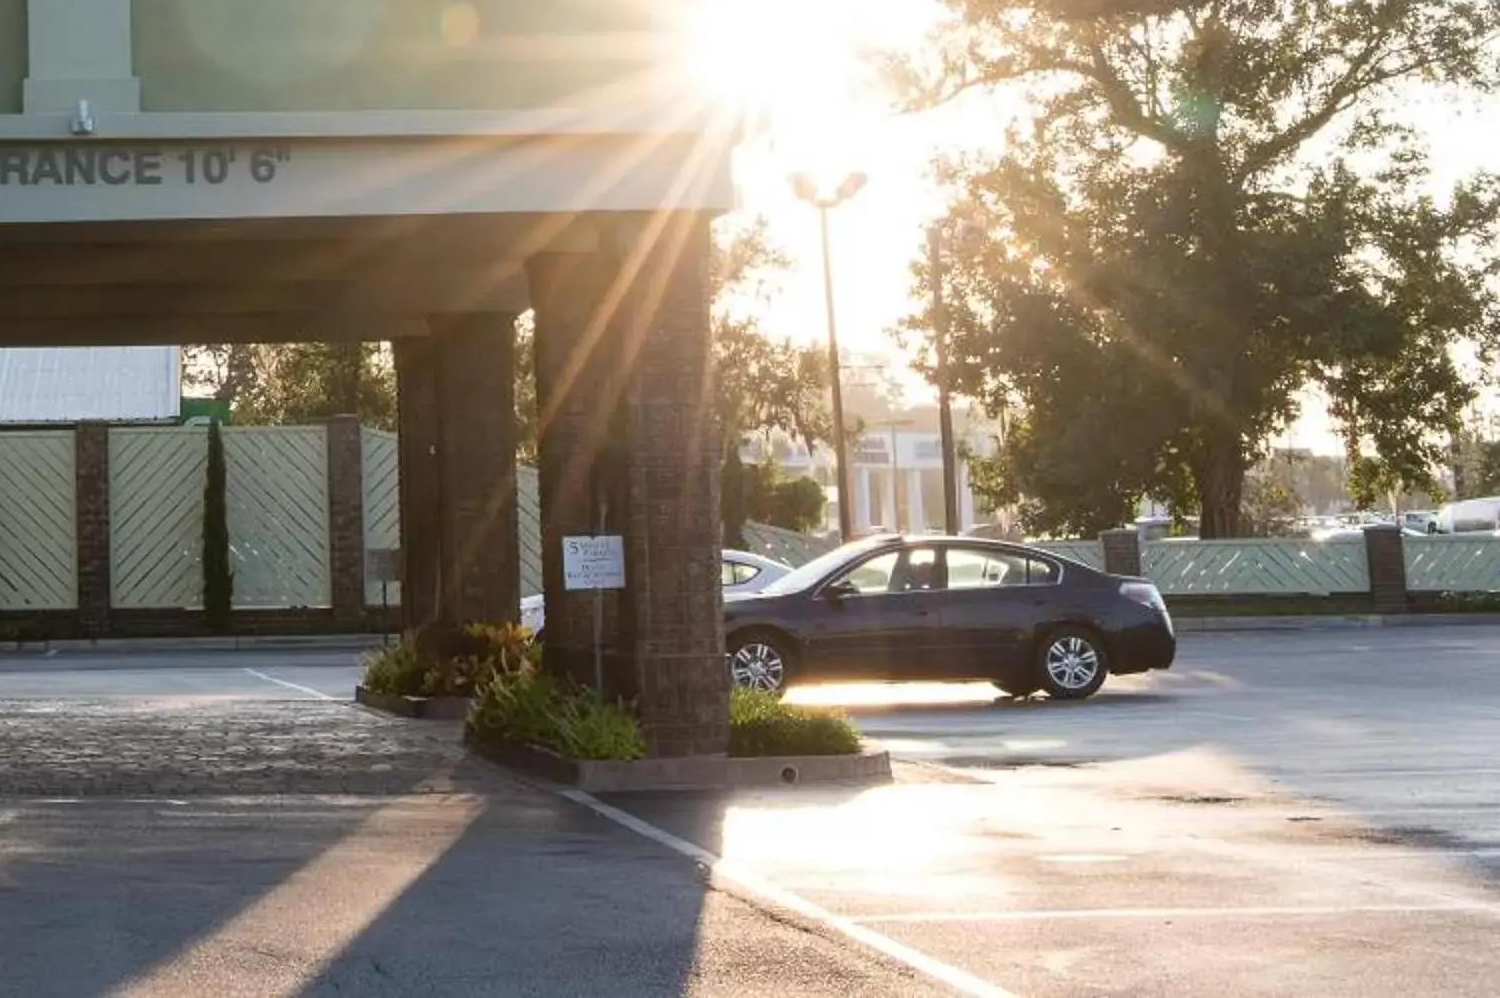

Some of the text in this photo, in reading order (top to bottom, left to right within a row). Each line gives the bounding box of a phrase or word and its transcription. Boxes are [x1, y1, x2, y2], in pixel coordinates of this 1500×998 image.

[177, 147, 236, 184] 10'
[250, 146, 291, 183] 6"
[569, 541, 579, 555] 5
